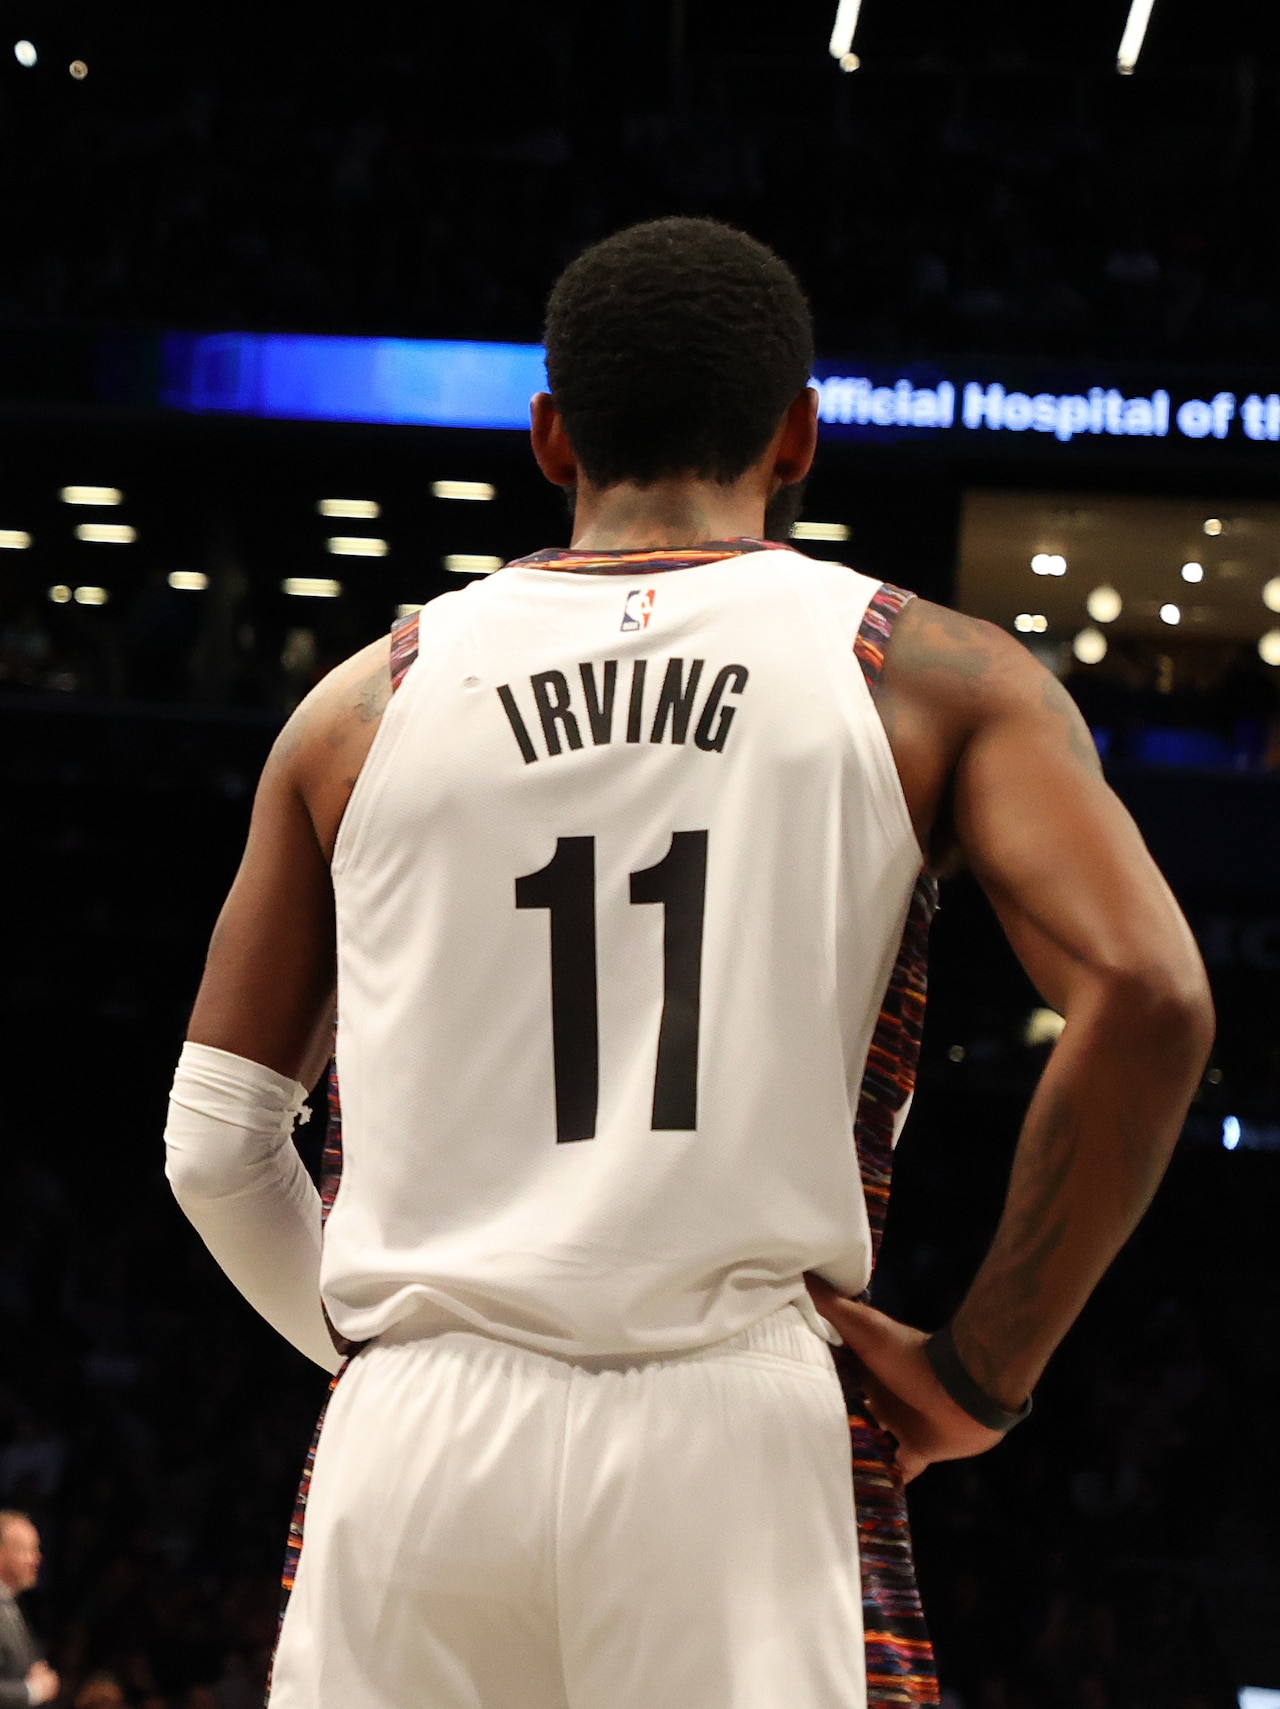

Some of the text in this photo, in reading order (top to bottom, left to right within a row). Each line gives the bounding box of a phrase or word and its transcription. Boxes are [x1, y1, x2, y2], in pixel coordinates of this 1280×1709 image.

[807, 377, 955, 428] fficial
[963, 382, 1170, 442] Hospital
[1177, 392, 1235, 439] of
[497, 658, 748, 764] IRVING
[515, 829, 709, 1144] 11
